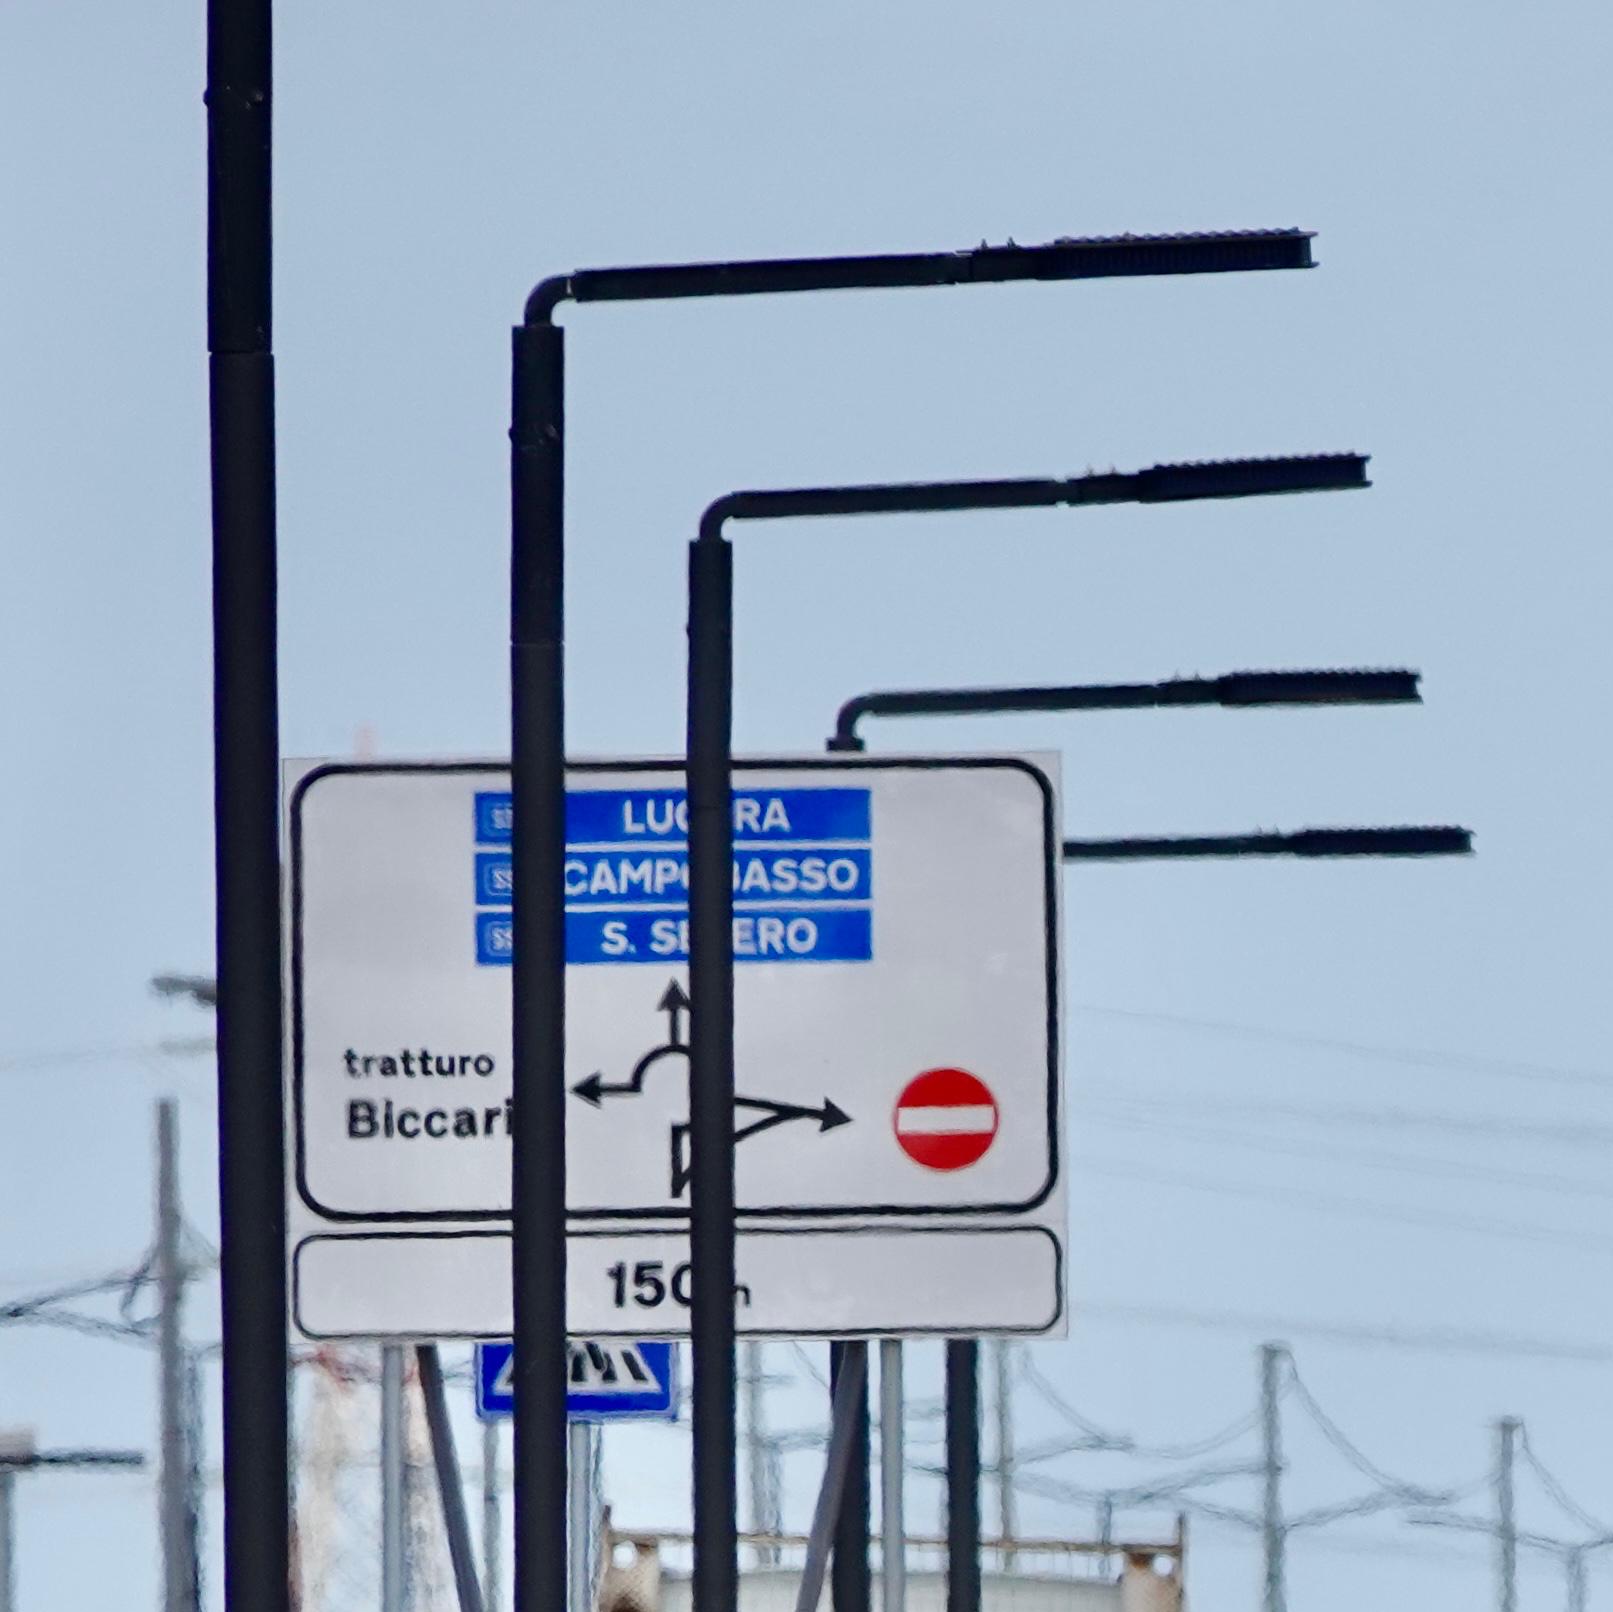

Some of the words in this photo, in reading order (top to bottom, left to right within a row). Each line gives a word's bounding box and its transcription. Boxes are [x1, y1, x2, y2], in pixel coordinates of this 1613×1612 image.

[622, 798, 791, 834] LUCRA
[563, 857, 859, 896] CAMPASSO
[601, 920, 637, 955] S.
[650, 916, 818, 955] SERO
[344, 1048, 495, 1078] tratturo
[347, 1097, 514, 1139] Biccari
